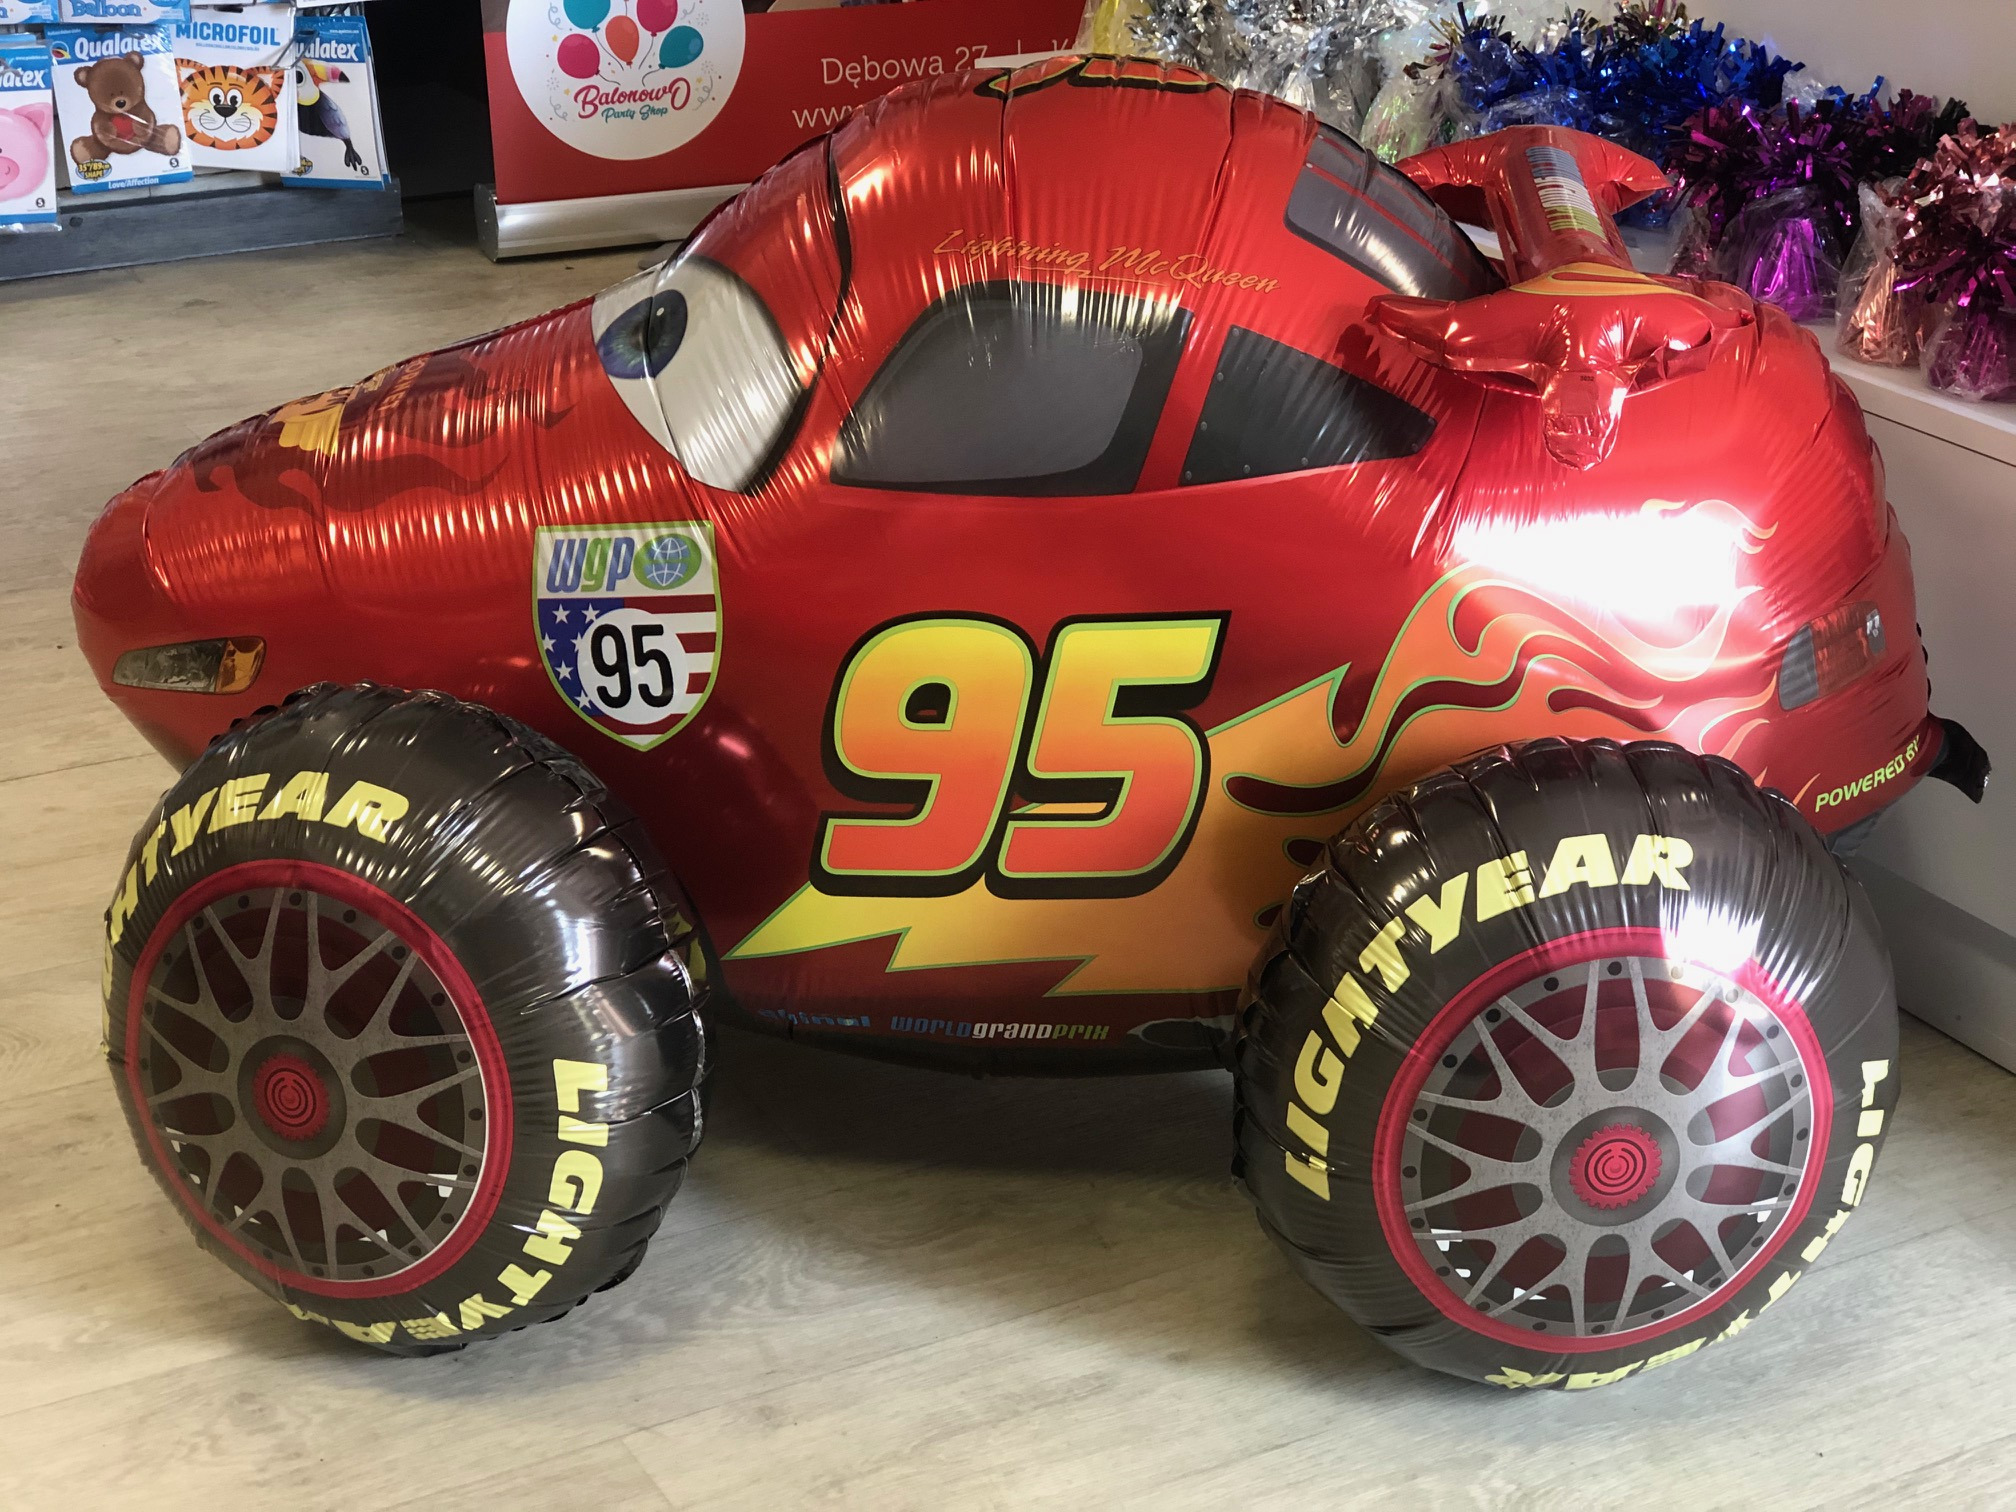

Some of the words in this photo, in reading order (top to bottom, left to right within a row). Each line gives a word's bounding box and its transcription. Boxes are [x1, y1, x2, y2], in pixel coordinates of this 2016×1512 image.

[175, 22, 281, 46] MICROFOIL
[296, 37, 359, 61] ualatex
[821, 55, 944, 88] Dębowa
[601, 107, 636, 123] Party
[639, 104, 668, 120] Shop
[791, 105, 853, 129] ww
[108, 177, 160, 190] Love/Affection
[1098, 246, 1280, 294] McQueen
[590, 623, 675, 709] 95
[814, 613, 1228, 892] 95
[1814, 753, 1906, 813] POWERED
[1905, 734, 1920, 762] BY
[1285, 833, 1694, 1201] LIGHTYEAR
